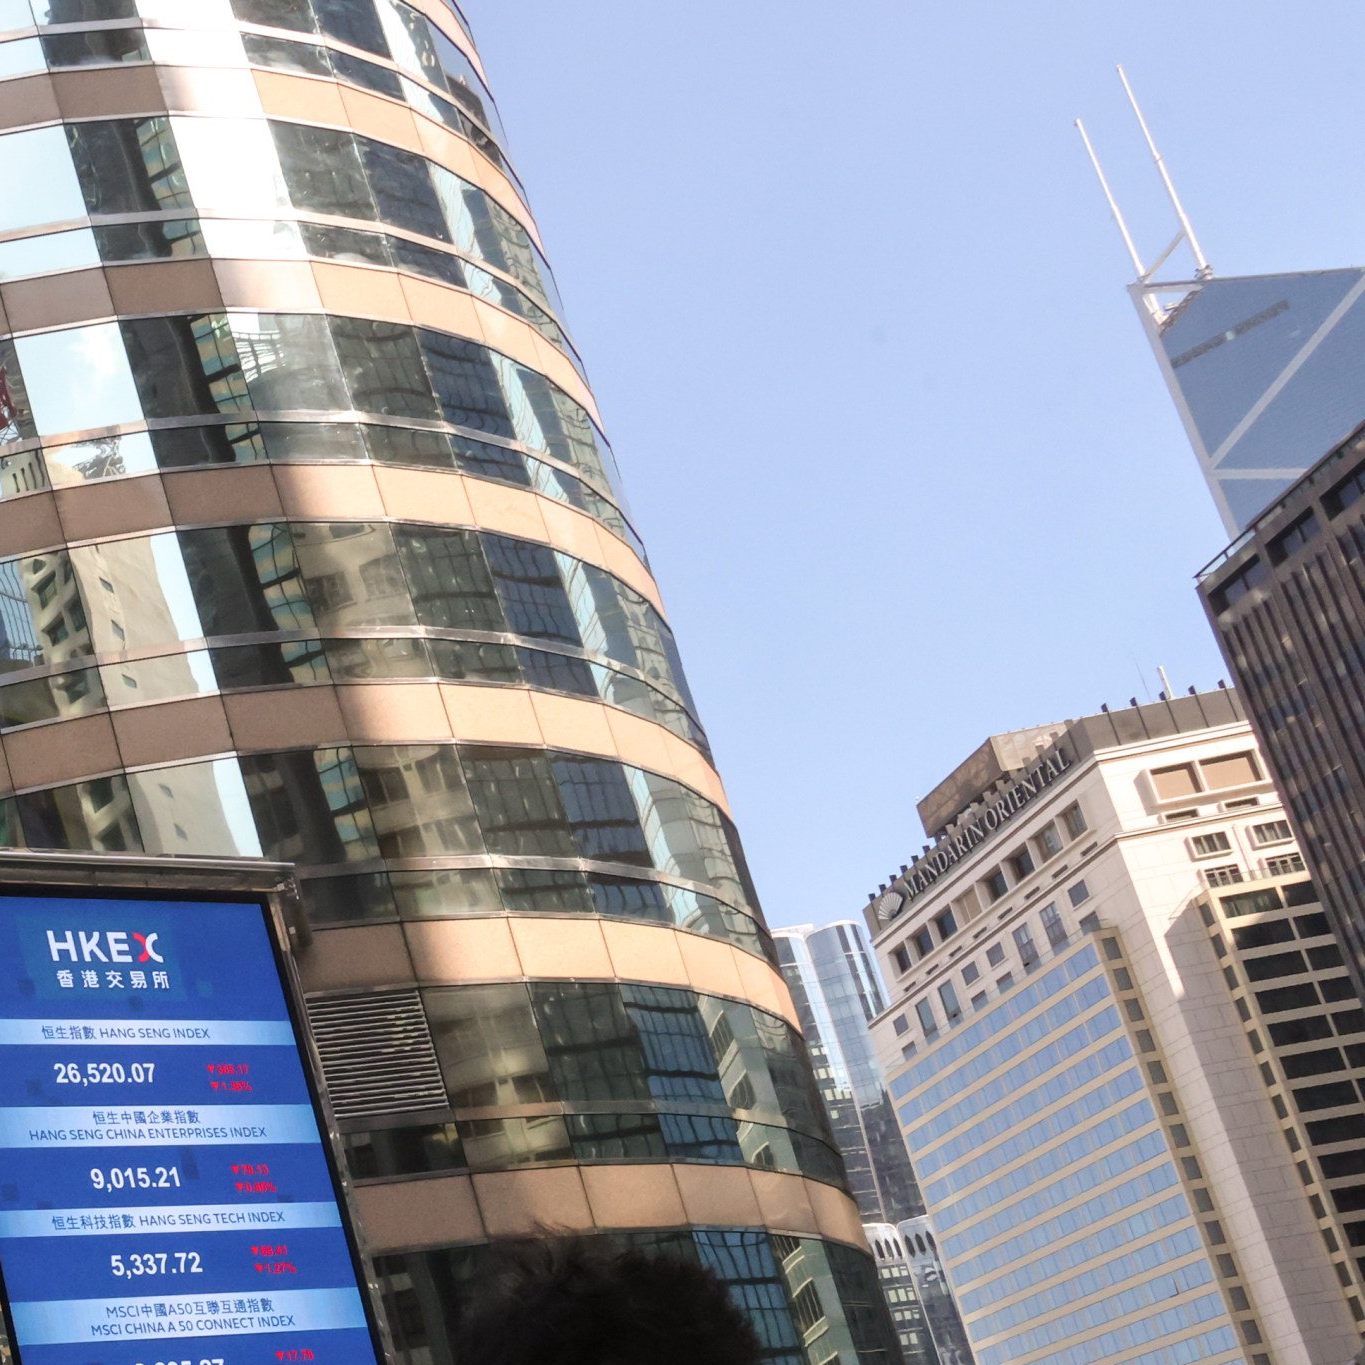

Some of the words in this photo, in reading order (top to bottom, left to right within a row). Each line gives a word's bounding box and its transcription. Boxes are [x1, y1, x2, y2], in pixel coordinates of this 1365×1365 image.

[903, 819, 984, 900] MANDARIN
[985, 749, 1070, 831] ORIENTAL
[46, 930, 164, 963] HKEX
[56, 969, 169, 989] 香港交易所
[41, 1025, 97, 1040] 恒生指數
[99, 1028, 136, 1038] HANG
[138, 1028, 171, 1039] SENG
[173, 1028, 211, 1039] INDEX
[53, 1063, 155, 1087] 26,520.07
[92, 1110, 201, 1126] 恒生中國企業指數
[29, 1130, 67, 1141] HANG
[69, 1129, 103, 1140] SENG
[106, 1128, 146, 1140] CHINA
[148, 1127, 229, 1139] ENTERPRISES
[230, 1126, 268, 1138] INDEX
[90, 1167, 180, 1192] 9,015.21
[50, 1214, 136, 1231] 恒生科技指數
[139, 1214, 176, 1226] HANG
[178, 1213, 212, 1225] SENG
[212, 1212, 246, 1224] TECH
[247, 1211, 286, 1223] INDEX
[111, 1252, 203, 1279] 5,337.72
[90, 1324, 122, 1336] MSCI
[124, 1322, 166, 1335] CHINA
[168, 1321, 177, 1332] A
[178, 1320, 194, 1332] 50
[196, 1317, 254, 1331] CONNECT
[258, 1315, 296, 1327] INDEX
